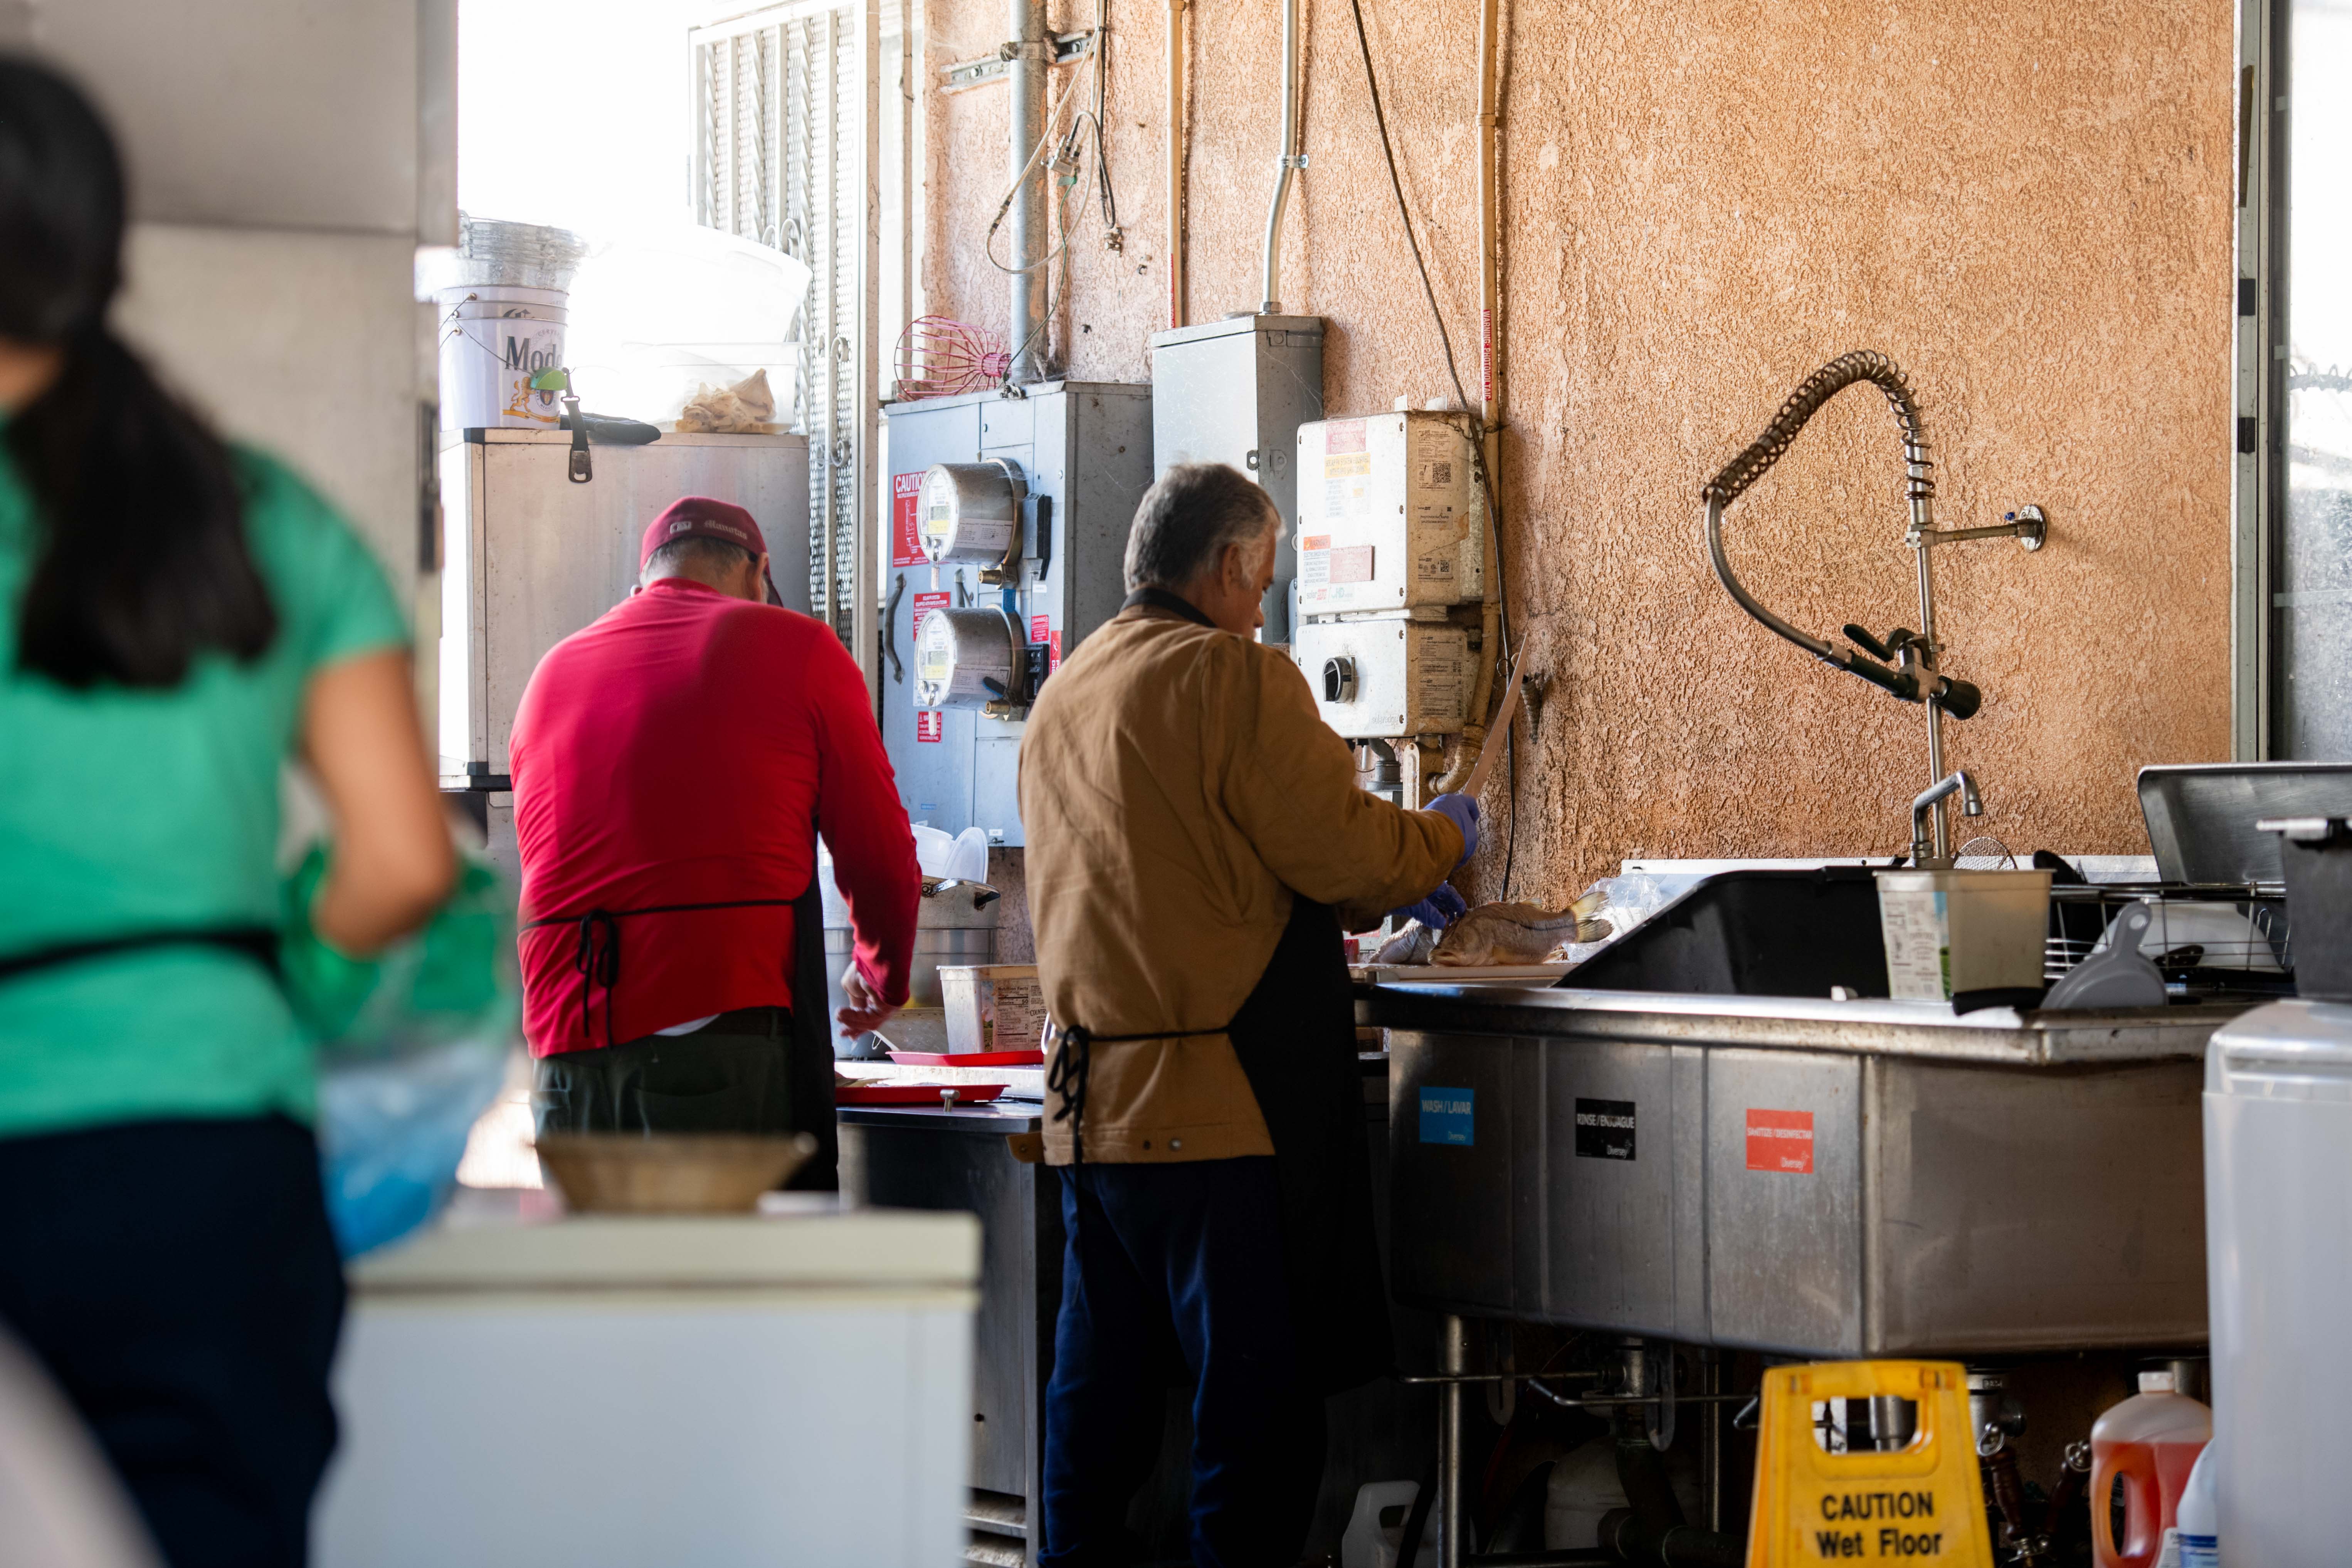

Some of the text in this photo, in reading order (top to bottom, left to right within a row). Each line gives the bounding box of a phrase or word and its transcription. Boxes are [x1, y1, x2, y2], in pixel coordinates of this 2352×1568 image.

[896, 472, 926, 493] CAUTIO
[1030, 1008, 1047, 1017] COUNTR
[1821, 1491, 1934, 1521] CAUTION
[1815, 1528, 1943, 1559] Wet Floor
